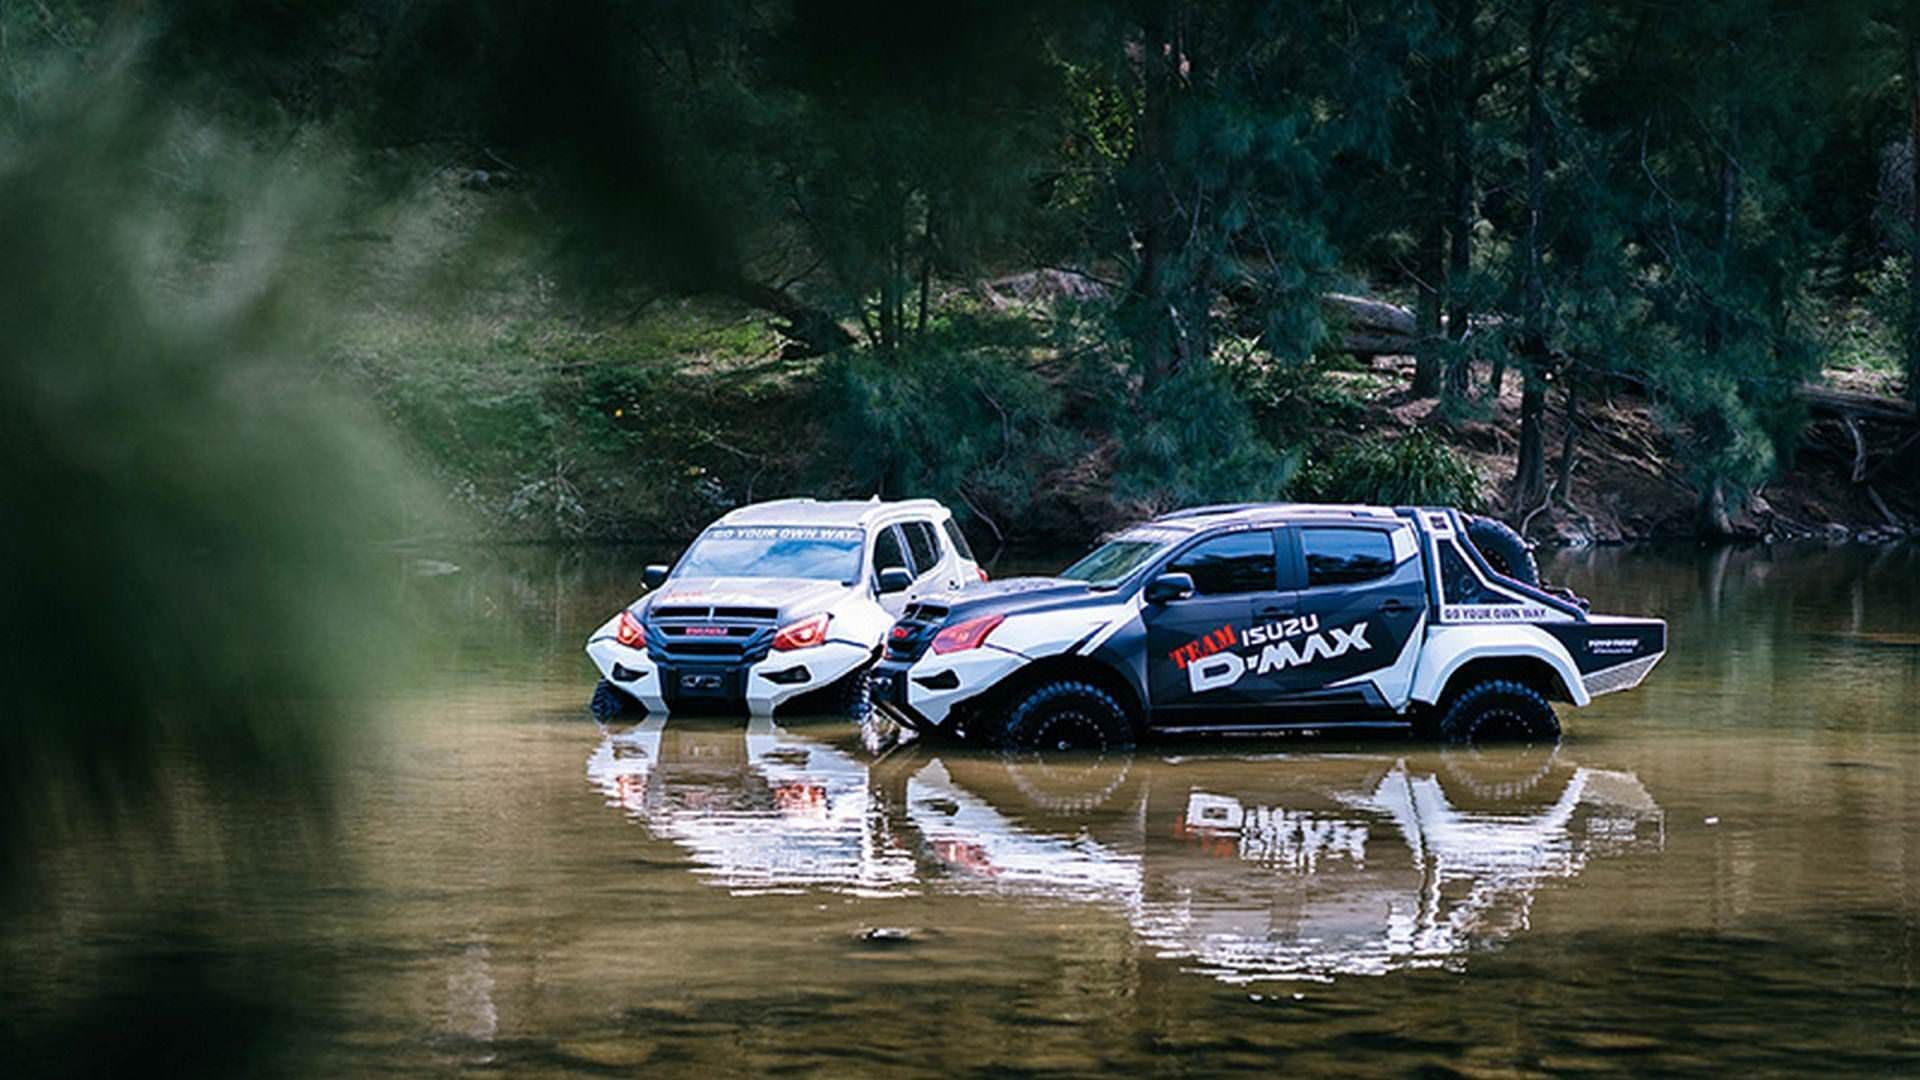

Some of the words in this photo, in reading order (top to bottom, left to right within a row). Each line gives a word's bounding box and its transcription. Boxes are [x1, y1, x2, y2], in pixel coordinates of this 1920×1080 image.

[736, 529, 776, 539] YOUR
[779, 529, 816, 539] OWN
[820, 530, 853, 540] WAY
[1444, 608, 1460, 619] GO
[1462, 608, 1490, 619] YOUR
[1493, 608, 1520, 619] OWN
[1168, 624, 1237, 669] TEAM
[1241, 613, 1319, 647] ISUZU
[1187, 622, 1372, 693] D-MAX
